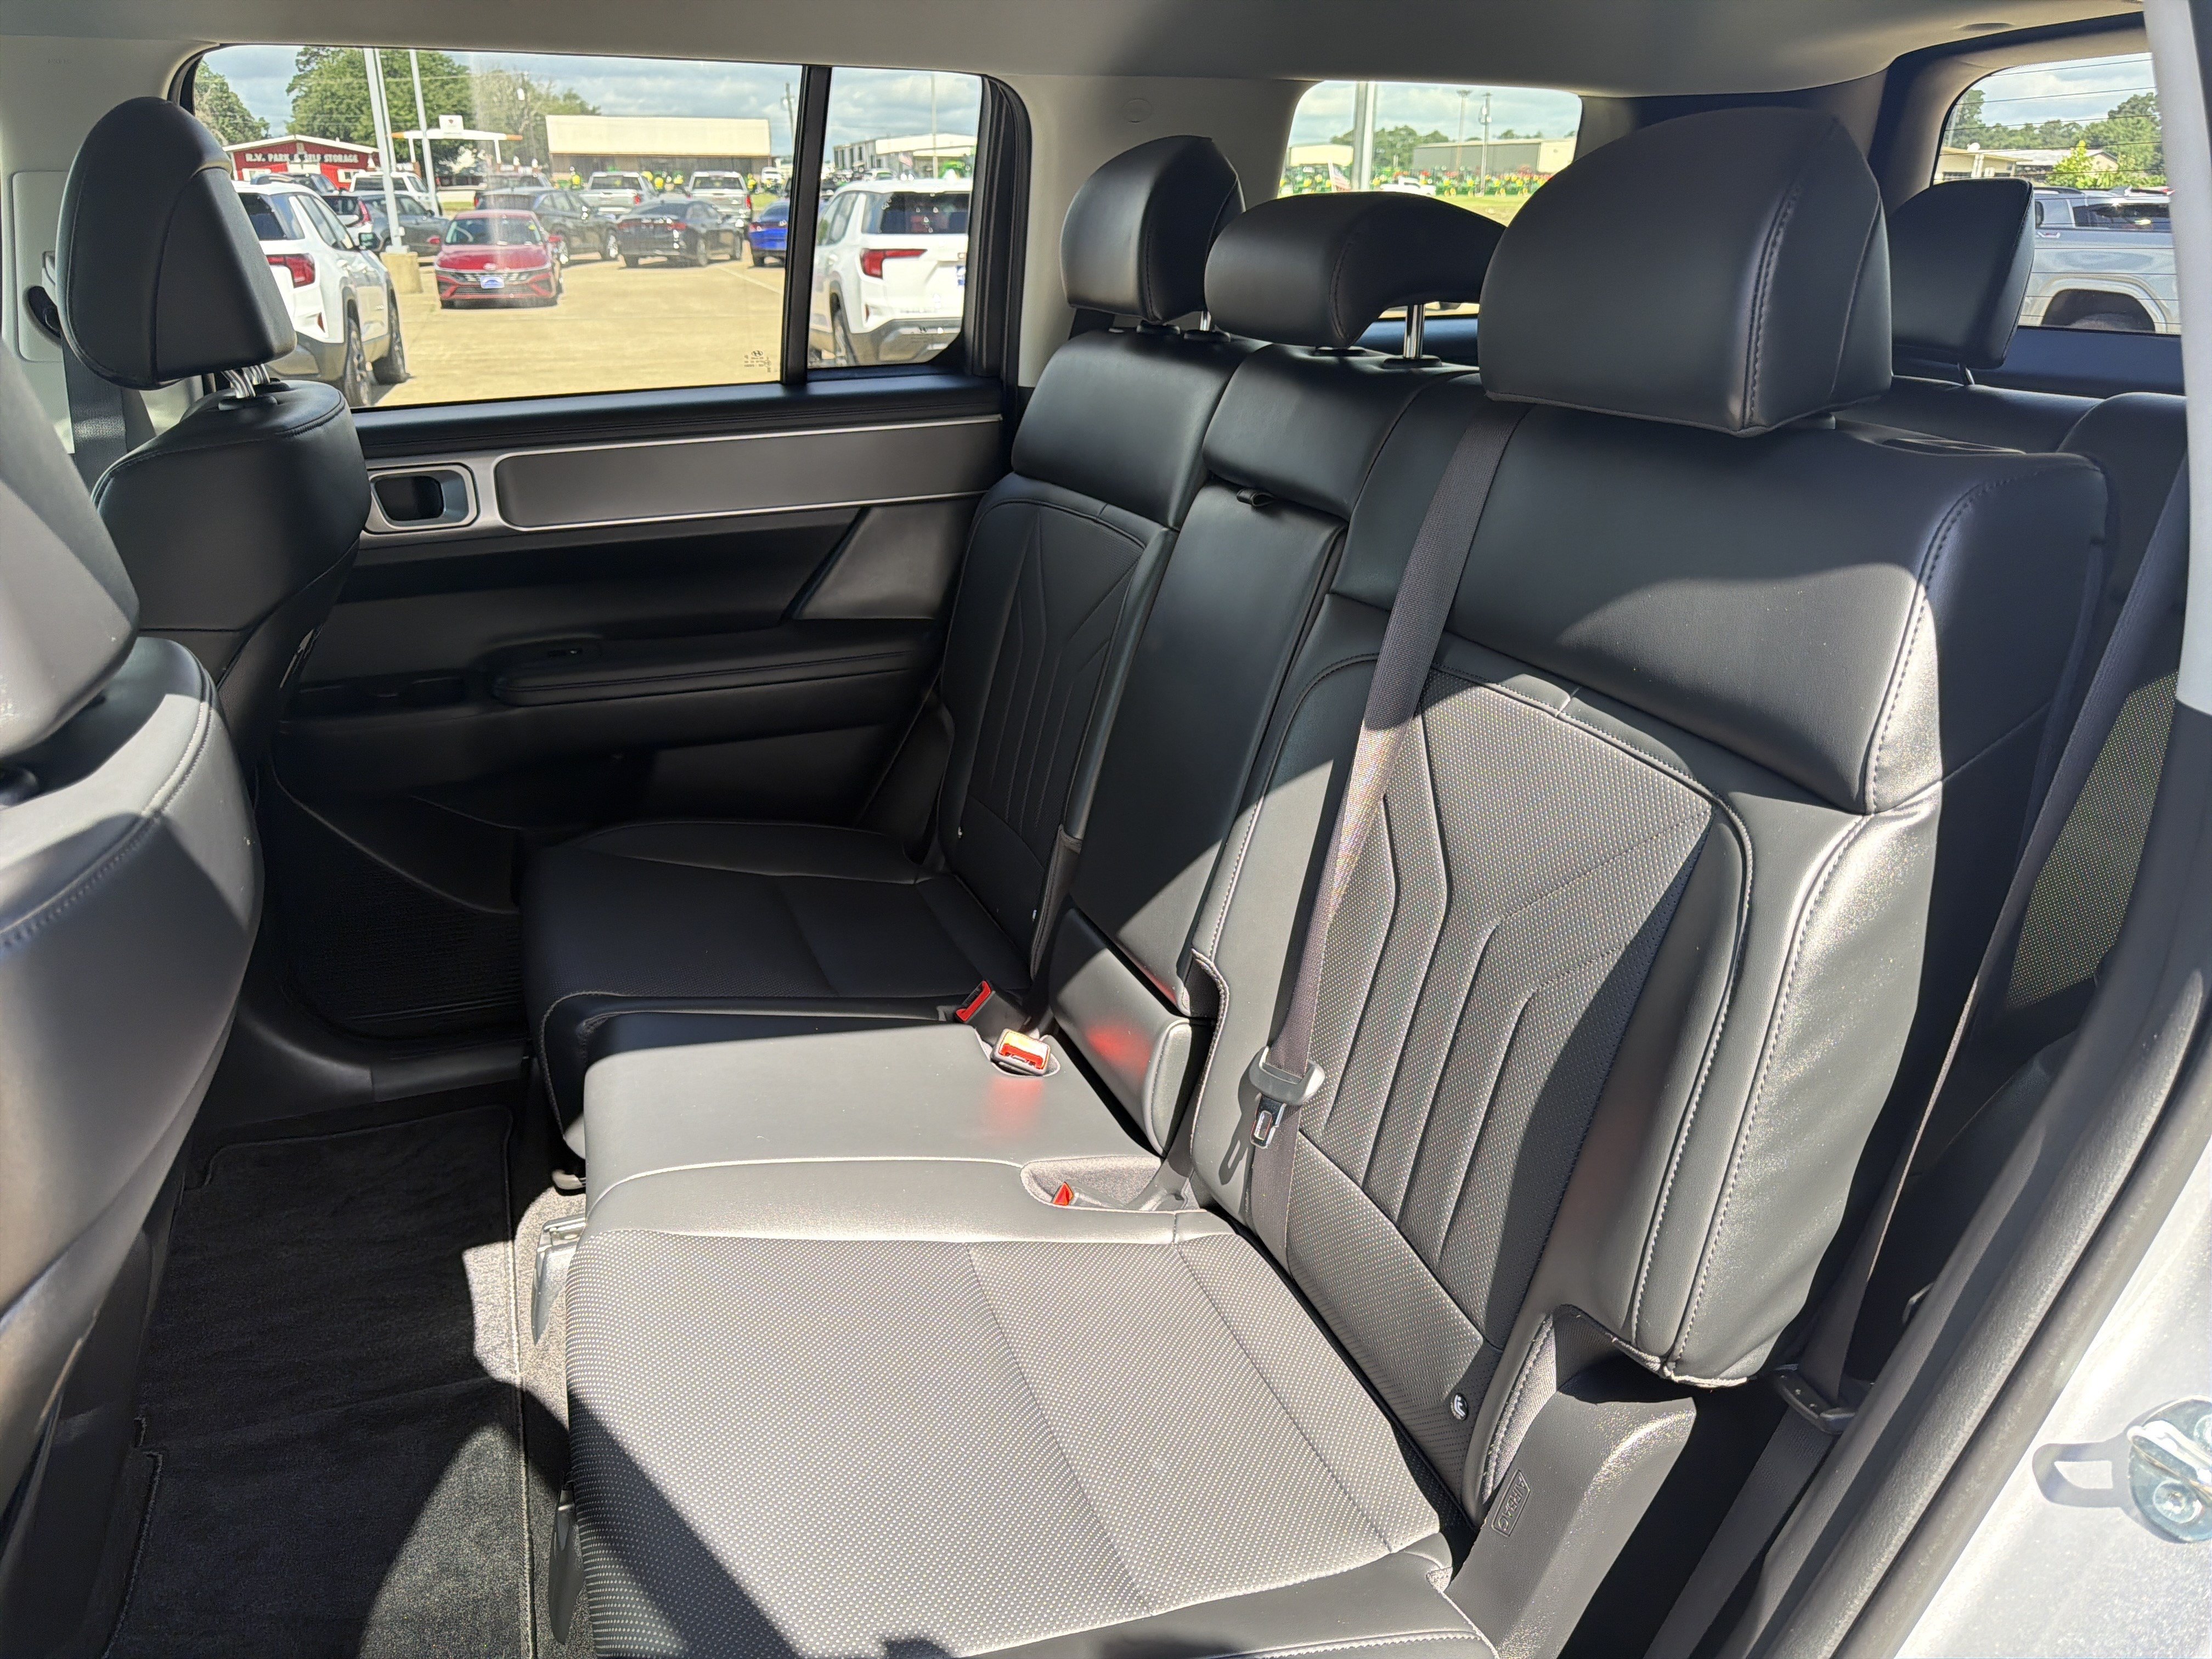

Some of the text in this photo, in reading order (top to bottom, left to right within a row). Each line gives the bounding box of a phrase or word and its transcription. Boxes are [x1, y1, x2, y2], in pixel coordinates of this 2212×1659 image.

[245, 153, 266, 162] R.V.
[268, 153, 290, 162] PARK
[324, 154, 359, 163] STORAGE
[1498, 1476, 1526, 1531] AIRBAG
